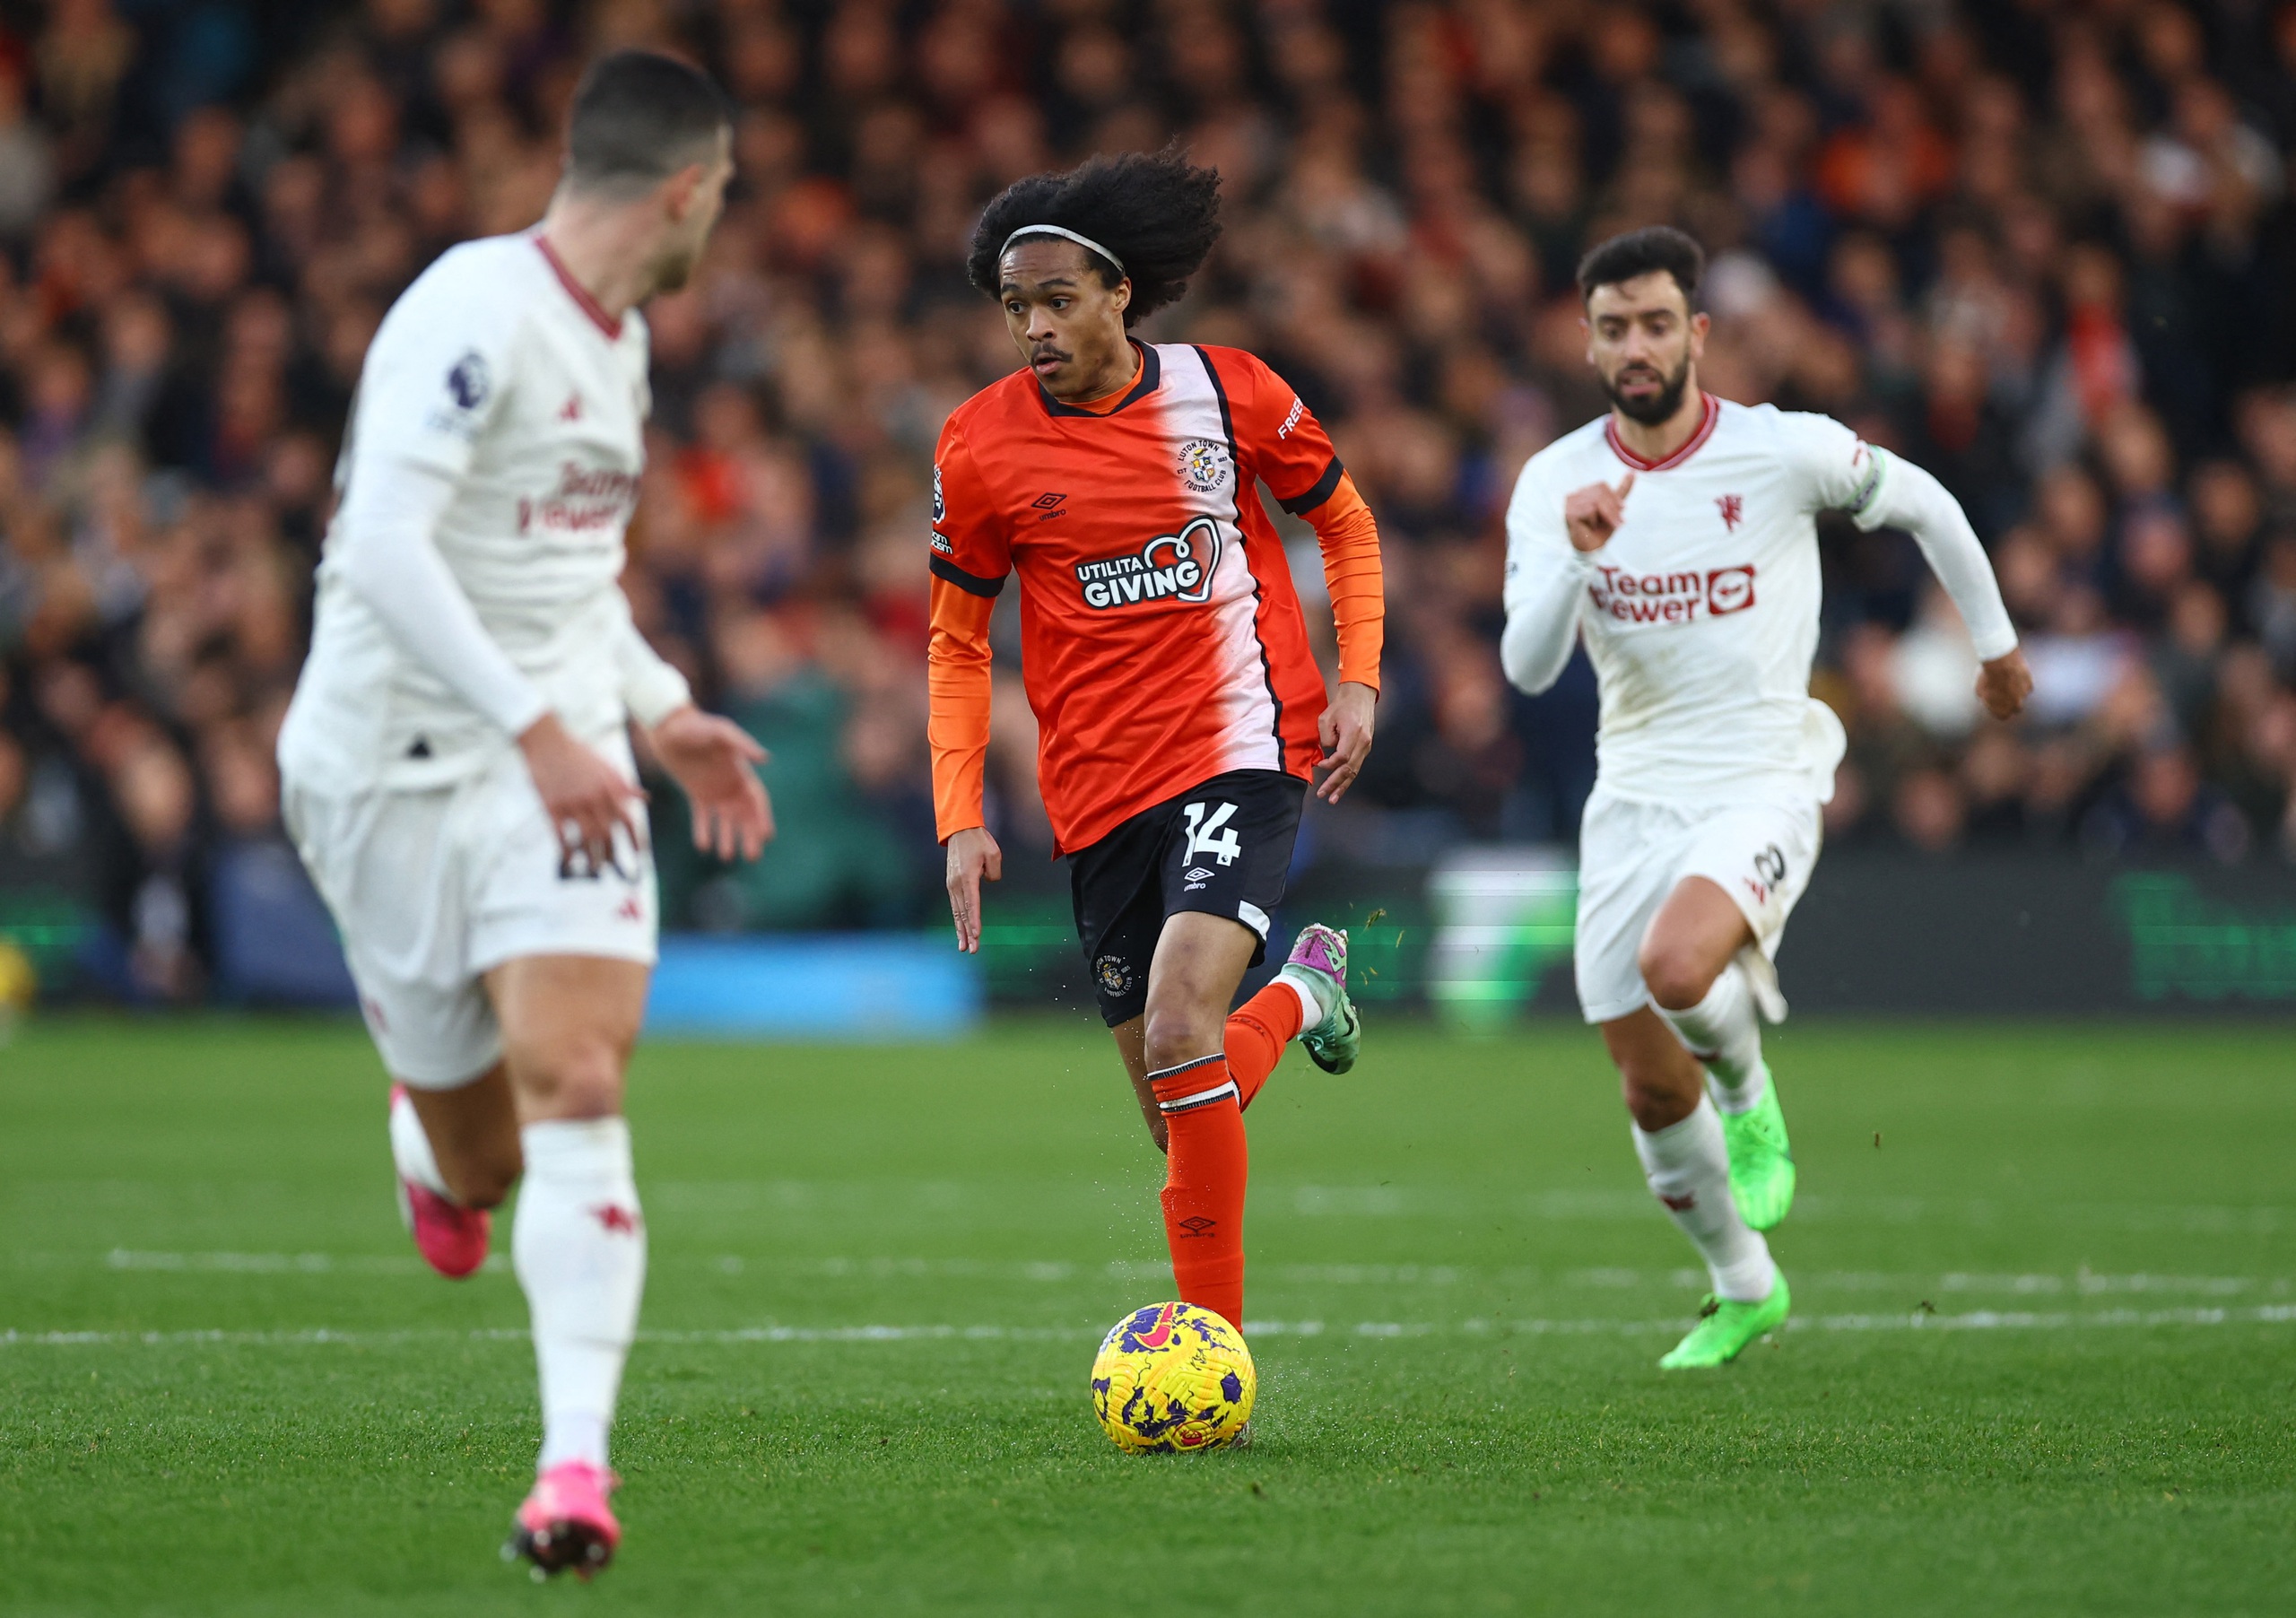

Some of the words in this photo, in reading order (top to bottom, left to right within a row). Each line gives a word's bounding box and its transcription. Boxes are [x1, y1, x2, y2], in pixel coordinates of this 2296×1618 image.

[1178, 441, 1197, 462] LUTON
[1198, 439, 1220, 452] TOWN
[1184, 480, 1216, 492] FOOTBALL
[1214, 469, 1226, 486] CLUB
[1039, 508, 1066, 522] umbro
[1078, 556, 1144, 582] UTILITA
[1597, 565, 1700, 596] Team
[1084, 561, 1200, 607] GIVING
[1182, 801, 1241, 868] 14
[1184, 882, 1206, 892] umbro
[1103, 954, 1122, 965] TOWN
